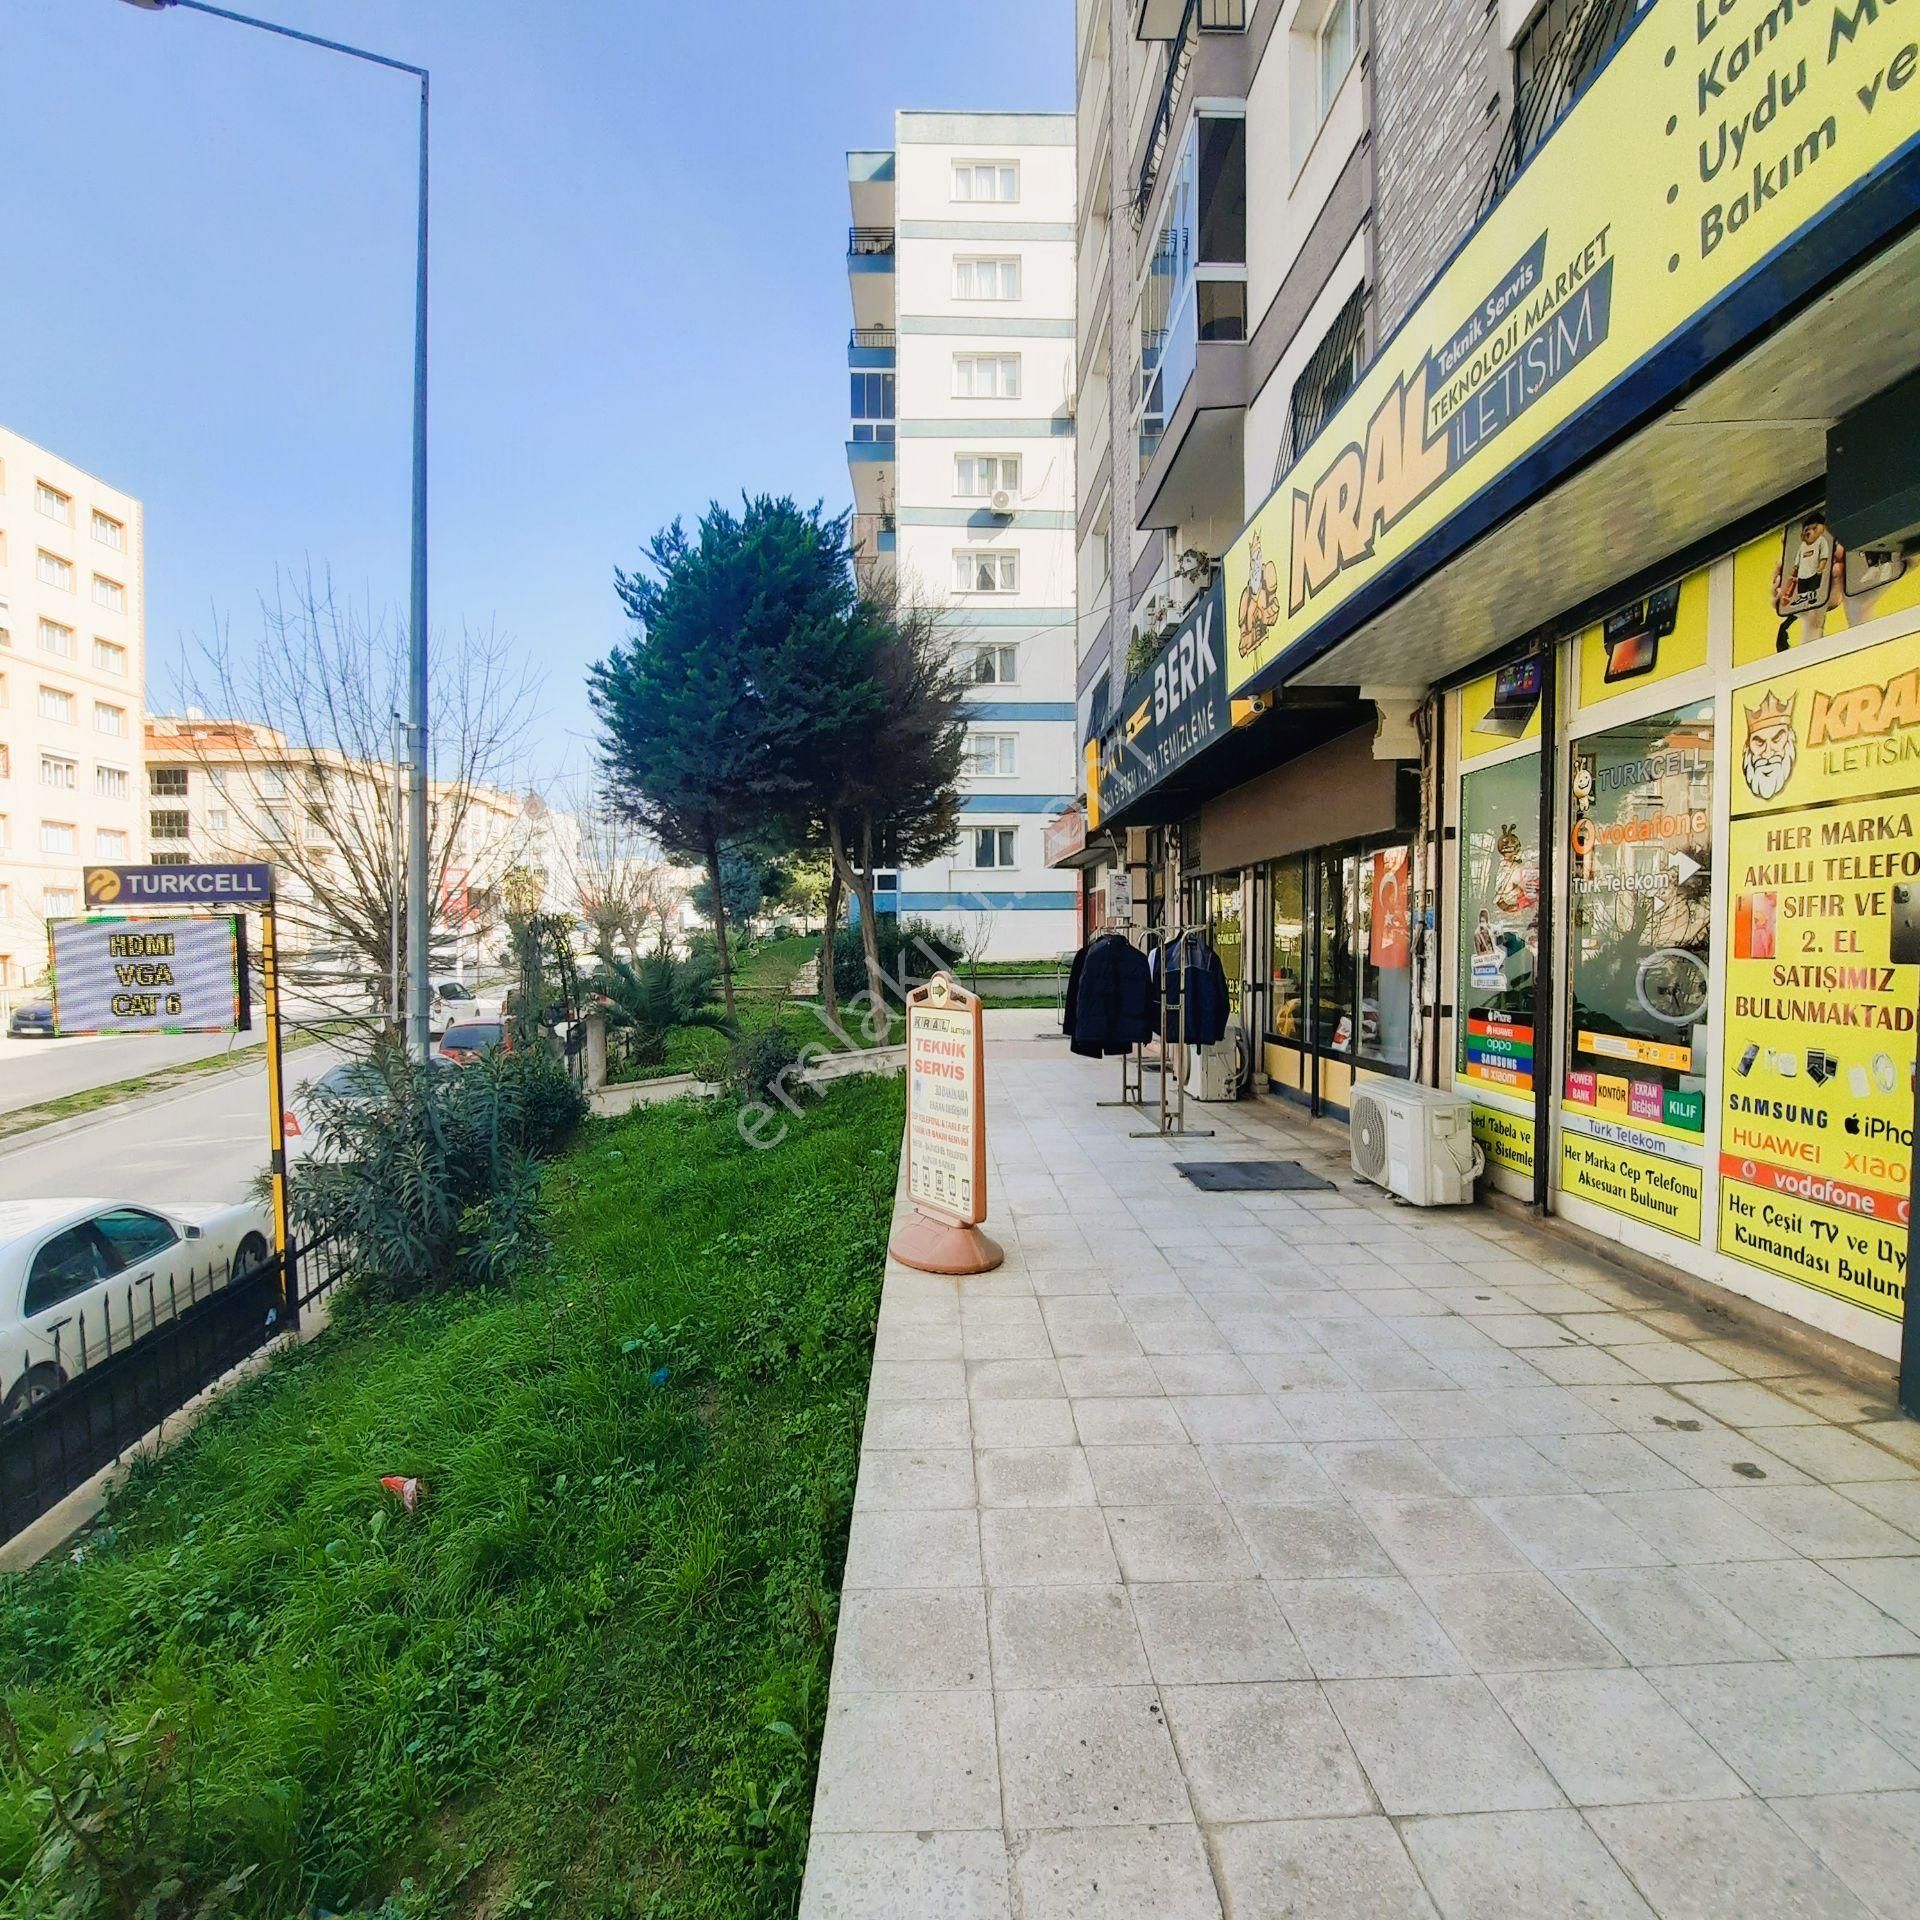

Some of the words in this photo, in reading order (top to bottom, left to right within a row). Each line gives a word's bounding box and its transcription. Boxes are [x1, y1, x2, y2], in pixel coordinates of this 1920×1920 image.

[1699, 57, 1806, 183] Uydu
[1700, 115, 1837, 260] Bakım
[1856, 42, 1919, 115] ve
[1431, 314, 1518, 426] TEKNOLOJİ
[1524, 222, 1611, 336] MARKET
[1438, 316, 1483, 376] Teknik
[1486, 262, 1534, 328] Servis
[1288, 345, 1451, 620] KRAL
[1154, 600, 1218, 728] BERK
[1599, 748, 1707, 792] TURKCELL
[1599, 810, 1708, 846] vodafone
[1766, 826, 1812, 852] HER
[1821, 812, 1913, 847] MARKA
[126, 873, 262, 895] TURKCELL
[1605, 871, 1670, 892] Telekom
[1744, 860, 1814, 888] AKILLI
[1823, 851, 1920, 882] TELEFO
[1783, 894, 1845, 919] SIFIR
[1854, 892, 1887, 917] VE
[109, 933, 174, 957] HDMI
[1801, 930, 1824, 953] 2.
[1834, 930, 1865, 953] EL
[115, 964, 174, 987] VGA
[1772, 964, 1897, 993] SATIŞIMIZ
[111, 994, 160, 1017] CAT
[165, 994, 182, 1016] 6
[1735, 996, 1915, 1032] BULUNMAKTAD
[914, 1016, 949, 1032] KRAL
[915, 1038, 967, 1059] TEKNİK
[1486, 1038, 1512, 1052] oppo
[914, 1059, 965, 1081] SERVİS
[1480, 1052, 1518, 1070] SAMSUNG
[1569, 1074, 1593, 1086] POWER
[1572, 1088, 1590, 1100] BANK
[1598, 1085, 1626, 1102] KONTÖR
[1634, 1083, 1658, 1099] EKRAN
[1669, 1100, 1697, 1119] KILIF
[1729, 1093, 1829, 1130] SAMSUNG
[1864, 1116, 1914, 1147] iPho
[1488, 1117, 1517, 1139] Tabela
[1520, 1131, 1531, 1144] ve
[1588, 1119, 1612, 1138] Türk
[1616, 1127, 1666, 1153] Telekom
[1732, 1127, 1822, 1165] HUAWEI
[1564, 1144, 1581, 1162] Her
[1585, 1150, 1616, 1174] Marka
[1620, 1161, 1641, 1184] Cep
[1645, 1169, 1698, 1200] Telefonu
[1578, 1169, 1627, 1199] Aksesuarı
[1630, 1186, 1679, 1217] Bulunur
[1773, 1171, 1876, 1214] vodafone
[1728, 1193, 1756, 1219] Her
[1762, 1205, 1802, 1234] Çeşit
[1810, 1219, 1839, 1245] TV
[1846, 1234, 1868, 1255] ve
[1735, 1223, 1830, 1274] Kumandası
